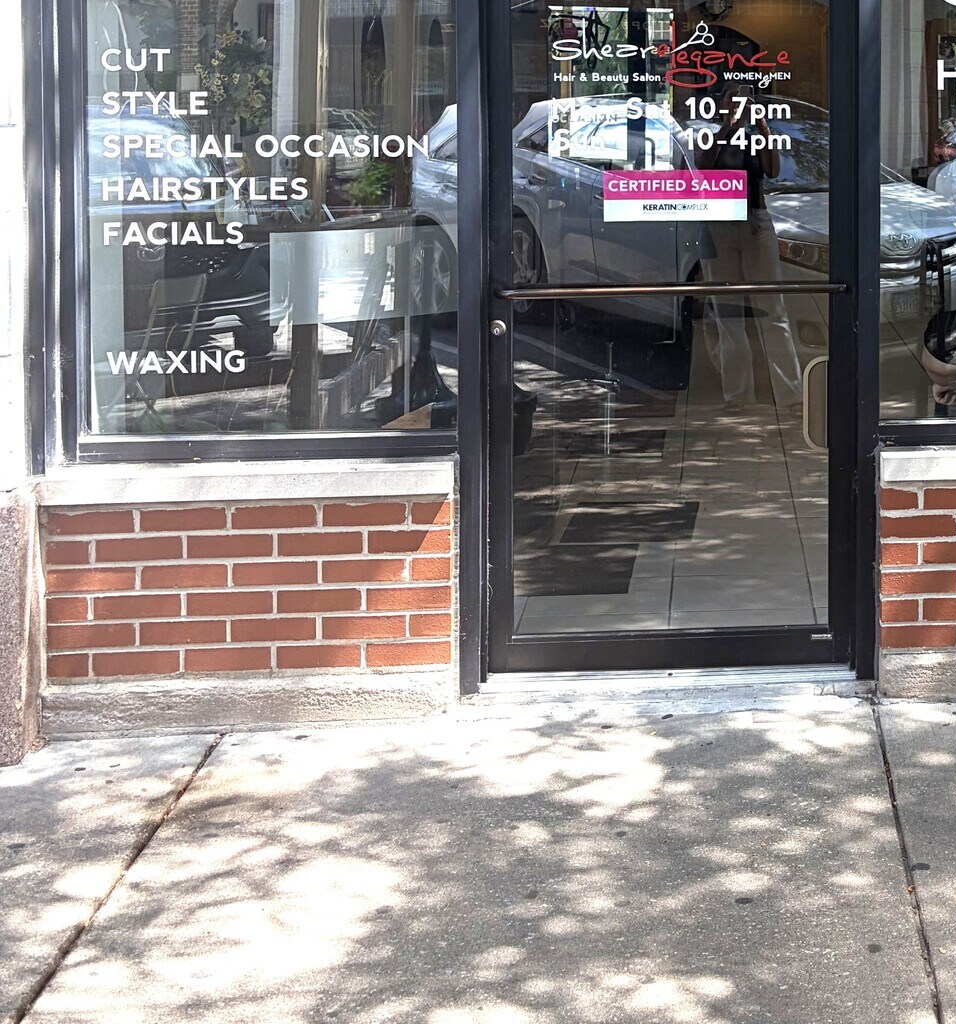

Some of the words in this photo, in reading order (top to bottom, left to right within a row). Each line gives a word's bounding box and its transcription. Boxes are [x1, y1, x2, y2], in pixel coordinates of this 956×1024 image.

[100, 48, 171, 72] CUT
[657, 20, 791, 88] elegance
[553, 72, 575, 83] Hair
[579, 72, 588, 83] &
[592, 72, 629, 85] Beauty
[632, 72, 661, 83] Salon
[723, 71, 762, 81] WOMEN
[769, 71, 791, 81] MEN
[102, 91, 208, 116] STYLE
[684, 96, 791, 126] 10-7pm
[102, 134, 243, 158] SPECIAL
[254, 134, 430, 159] OCCASION
[684, 127, 791, 156] 10-4pm
[102, 176, 309, 202] HAIRSTYLES
[608, 179, 687, 193] CERTIFIED
[691, 178, 744, 192] SALON
[103, 221, 244, 246] FACIALS
[107, 349, 246, 375] WAXING
